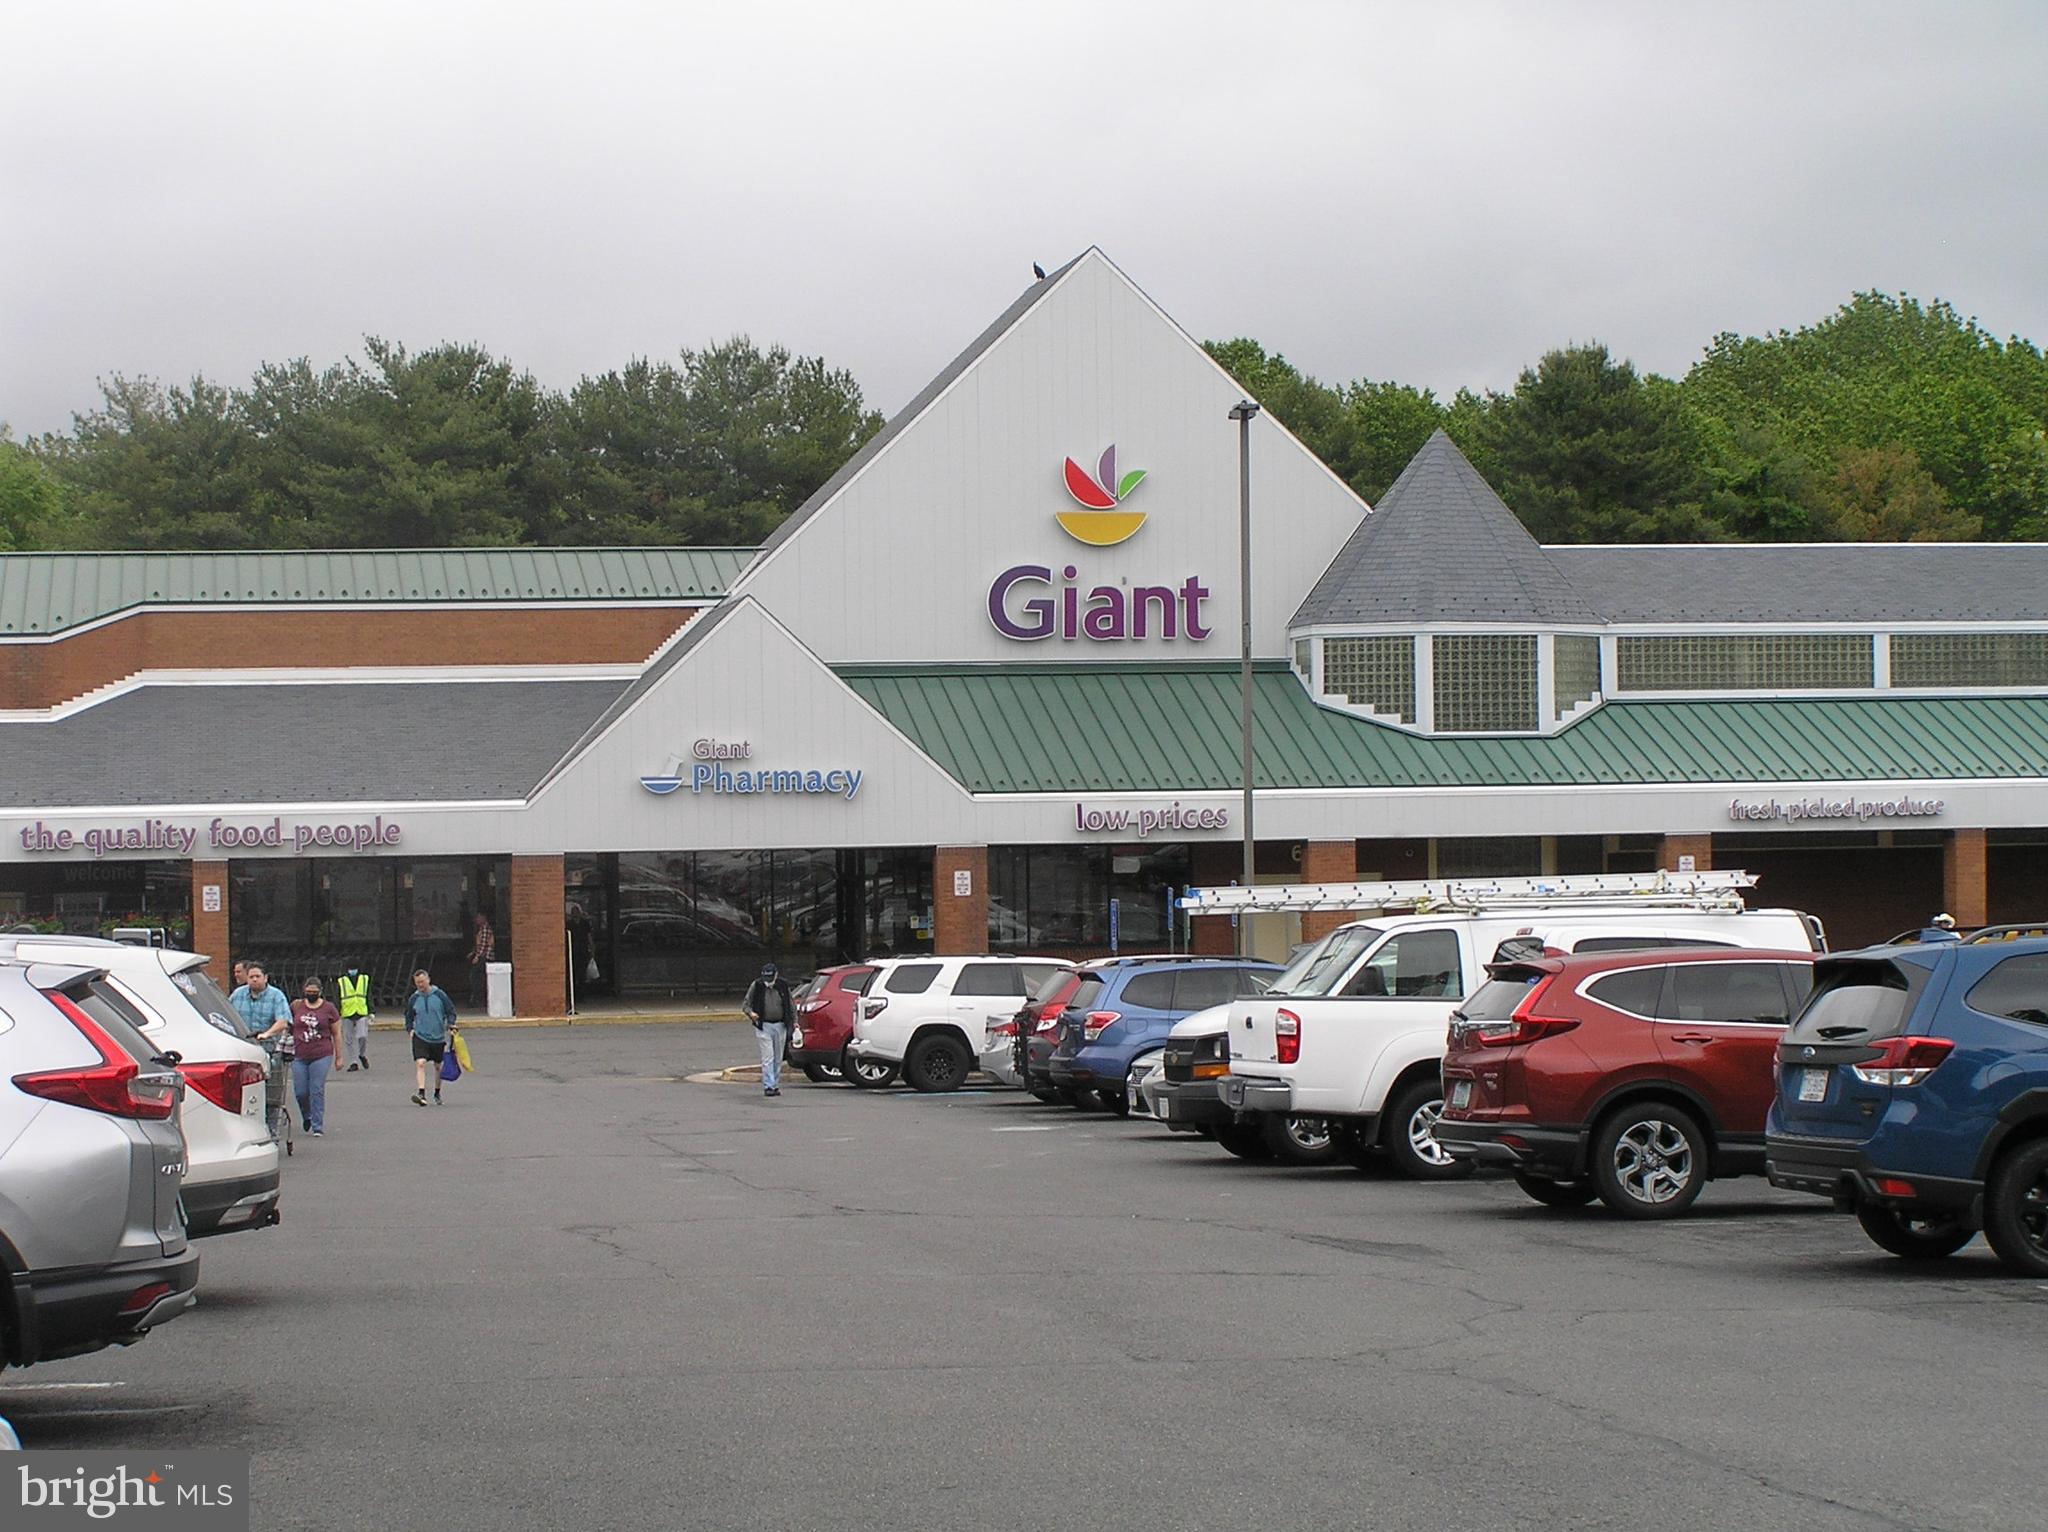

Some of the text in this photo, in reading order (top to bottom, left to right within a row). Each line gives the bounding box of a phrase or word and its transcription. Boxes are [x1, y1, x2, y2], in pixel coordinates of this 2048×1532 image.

[987, 564, 1212, 641] Giant
[692, 738, 751, 759] Giant
[692, 762, 863, 800] Pharmacy
[1075, 801, 1229, 838] low prices
[1728, 795, 1945, 824] fresh picked produce
[19, 815, 401, 856] the quality food people
[64, 863, 137, 882] welcome
